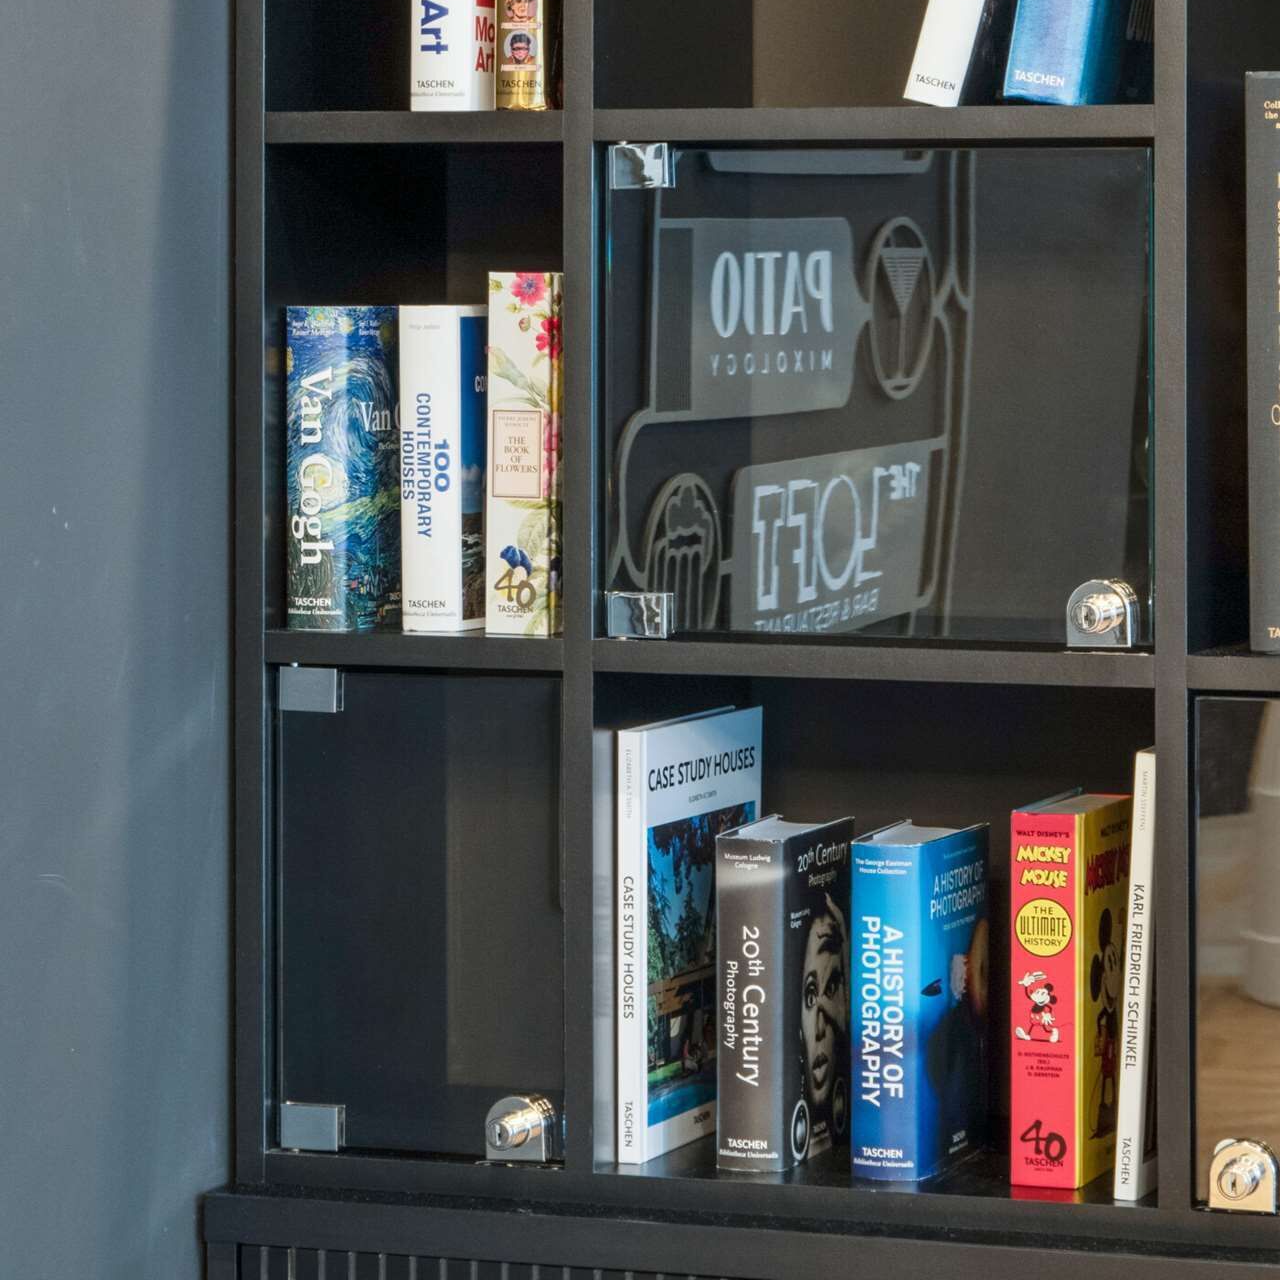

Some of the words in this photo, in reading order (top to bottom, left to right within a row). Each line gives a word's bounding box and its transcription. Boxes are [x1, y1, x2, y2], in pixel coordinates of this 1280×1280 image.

[417, 79, 455, 89] TASCHEN
[500, 79, 542, 89] TASCHEN
[915, 73, 956, 91] TASCHEN
[1014, 70, 1065, 87] TASCHEN
[1264, 110, 1279, 120] the
[299, 366, 333, 446] Van
[360, 401, 392, 433] Van
[503, 445, 529, 455] BOOK
[507, 435, 526, 445] THE
[402, 430, 415, 500] HOUSES
[416, 392, 432, 538] CONTEMPORARY
[434, 438, 451, 493] 100
[495, 464, 538, 473] FLOWERS
[510, 455, 522, 464] OF
[291, 453, 335, 567] Gogh
[294, 597, 332, 607] TASCHEN
[407, 599, 446, 609] TASCHEN
[648, 764, 676, 792] CASE
[677, 755, 713, 785] STUDY
[713, 746, 756, 776] HOUSES
[1016, 830, 1035, 838] WALT
[724, 853, 749, 861] Museum
[749, 854, 772, 863] Ludwig
[797, 846, 815, 873] 20th
[815, 840, 849, 867] Century
[1015, 845, 1072, 864] MICKEY
[623, 876, 634, 910] CASE
[940, 865, 974, 894] HISTORY
[1019, 868, 1069, 888] MOUSE
[930, 881, 985, 921] PHOTOGRAPHY
[1033, 906, 1054, 915] THE
[1132, 884, 1145, 918] KARL
[623, 914, 634, 959] STUDY
[882, 925, 904, 944] A
[1019, 915, 1067, 938] ULTIMATE
[1023, 937, 1063, 947] HISTORY
[742, 924, 766, 977] 20th
[1129, 923, 1144, 996] FRIEDRICH
[623, 963, 635, 1020] HOUSES
[723, 960, 740, 1050] Photography
[882, 948, 904, 1059] HISTORY
[861, 915, 881, 1108] PHOTOGRAPHY
[736, 984, 766, 1087] Century
[1125, 1001, 1140, 1070] SCHINKEL
[882, 1063, 904, 1099] OF
[624, 1101, 634, 1148] TASCHEN
[1020, 1119, 1067, 1162] 40
[728, 1138, 768, 1150] TASCHEN
[862, 1146, 903, 1158] TASCHEN
[1024, 1156, 1064, 1168] TASCHEN
[1120, 1137, 1132, 1185] TASCHEN
